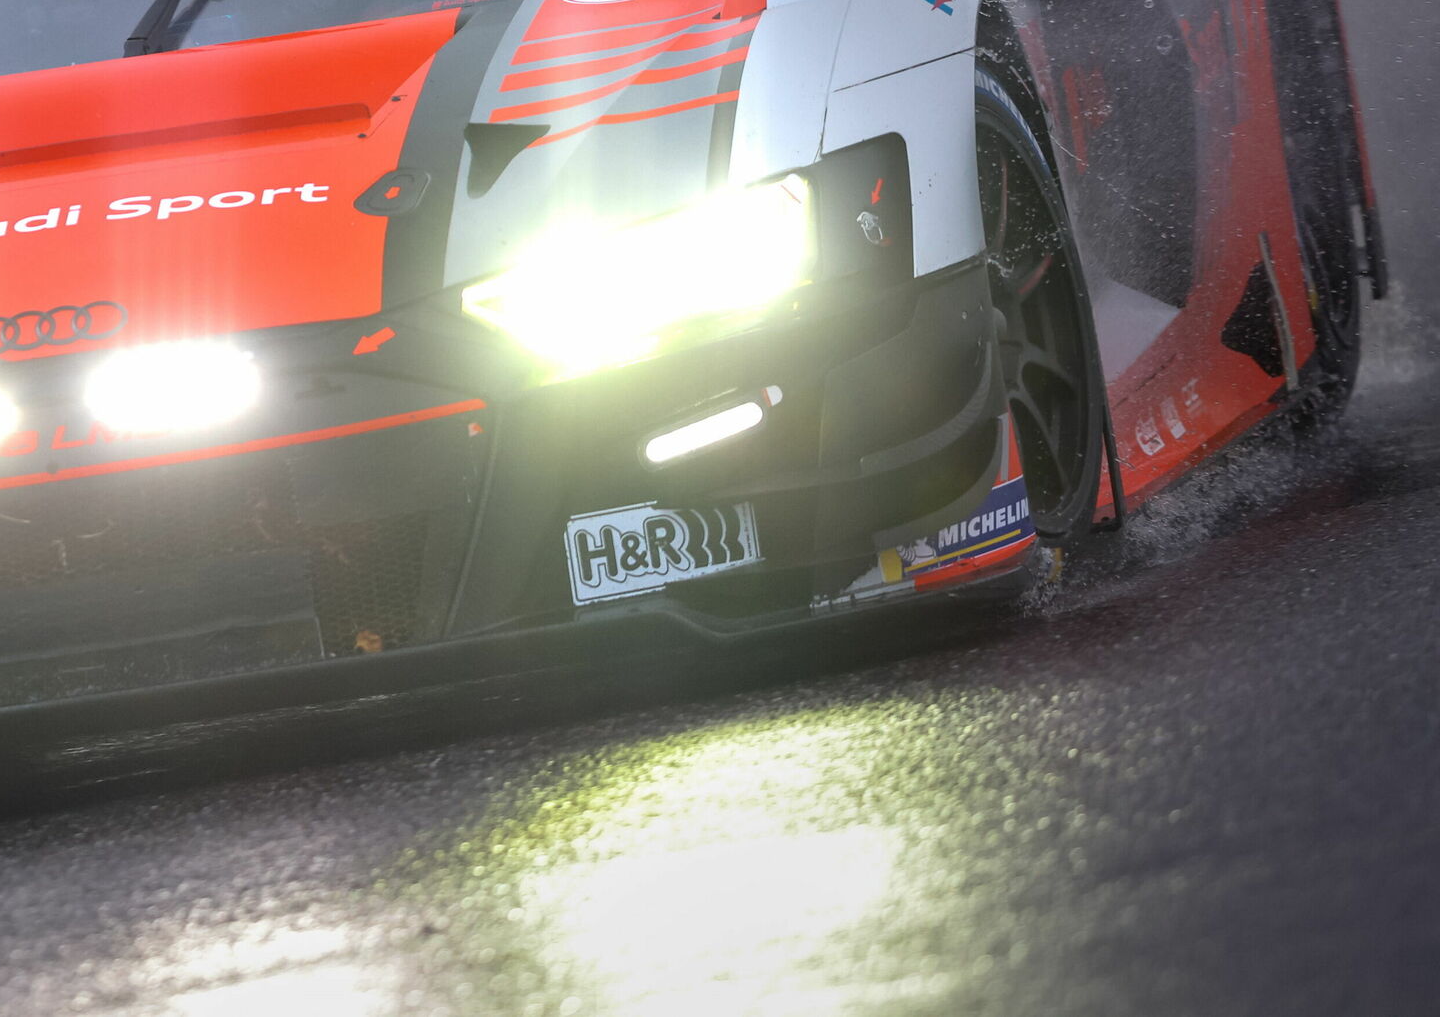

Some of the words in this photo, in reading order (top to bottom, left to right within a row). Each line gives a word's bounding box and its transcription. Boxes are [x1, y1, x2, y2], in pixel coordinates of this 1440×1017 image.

[105, 182, 330, 221] Sport
[574, 516, 684, 583] H&R
[938, 496, 1030, 552] MICHELIN
